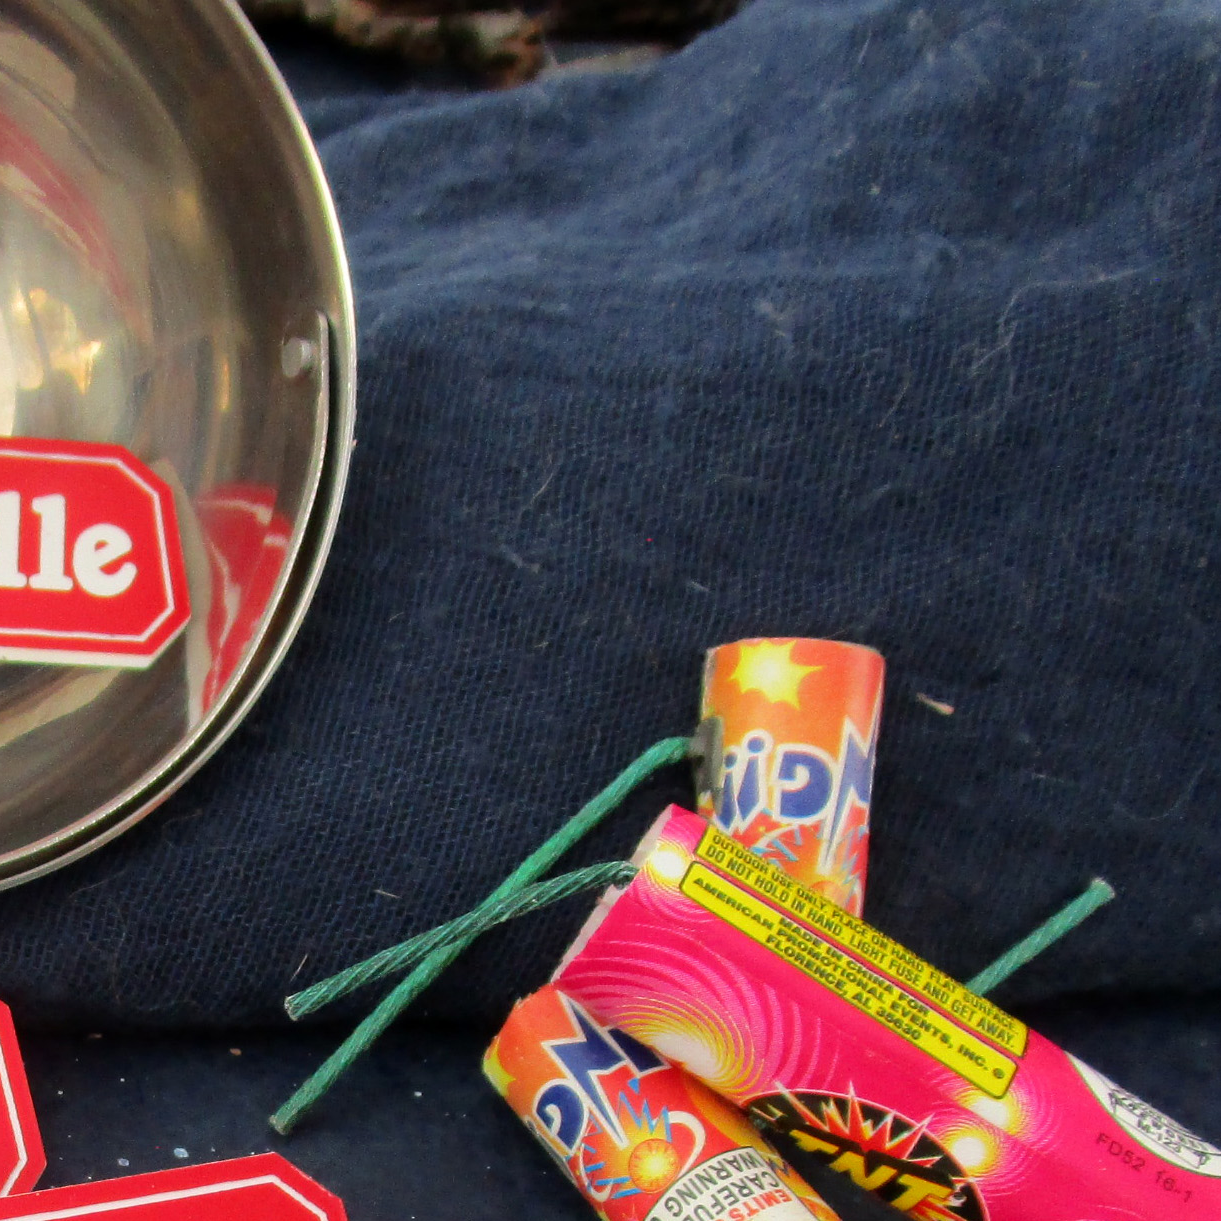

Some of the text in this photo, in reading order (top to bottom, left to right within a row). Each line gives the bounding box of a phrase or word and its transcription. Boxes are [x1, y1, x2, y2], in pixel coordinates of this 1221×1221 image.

[705, 845, 1016, 1049] DO NOT HOLD IN HAND. LIGHT FUSE AND GET AWAY.
[712, 834, 769, 875] OUTDOOR
[771, 869, 796, 891] USE
[832, 908, 869, 939] PLACE
[870, 931, 889, 950] ON
[891, 944, 925, 973] HARD
[929, 970, 957, 995] FLAT
[693, 876, 990, 1072] AMERICAN PROMOTIONAL EVENTS, INC.
[765, 933, 848, 998] FLORENCE,
[851, 991, 874, 1011] AL
[779, 916, 931, 1016] MADE IN CHINA FOR
[663, 1150, 770, 1219] WARNING
[788, 1128, 955, 1212] TNT
